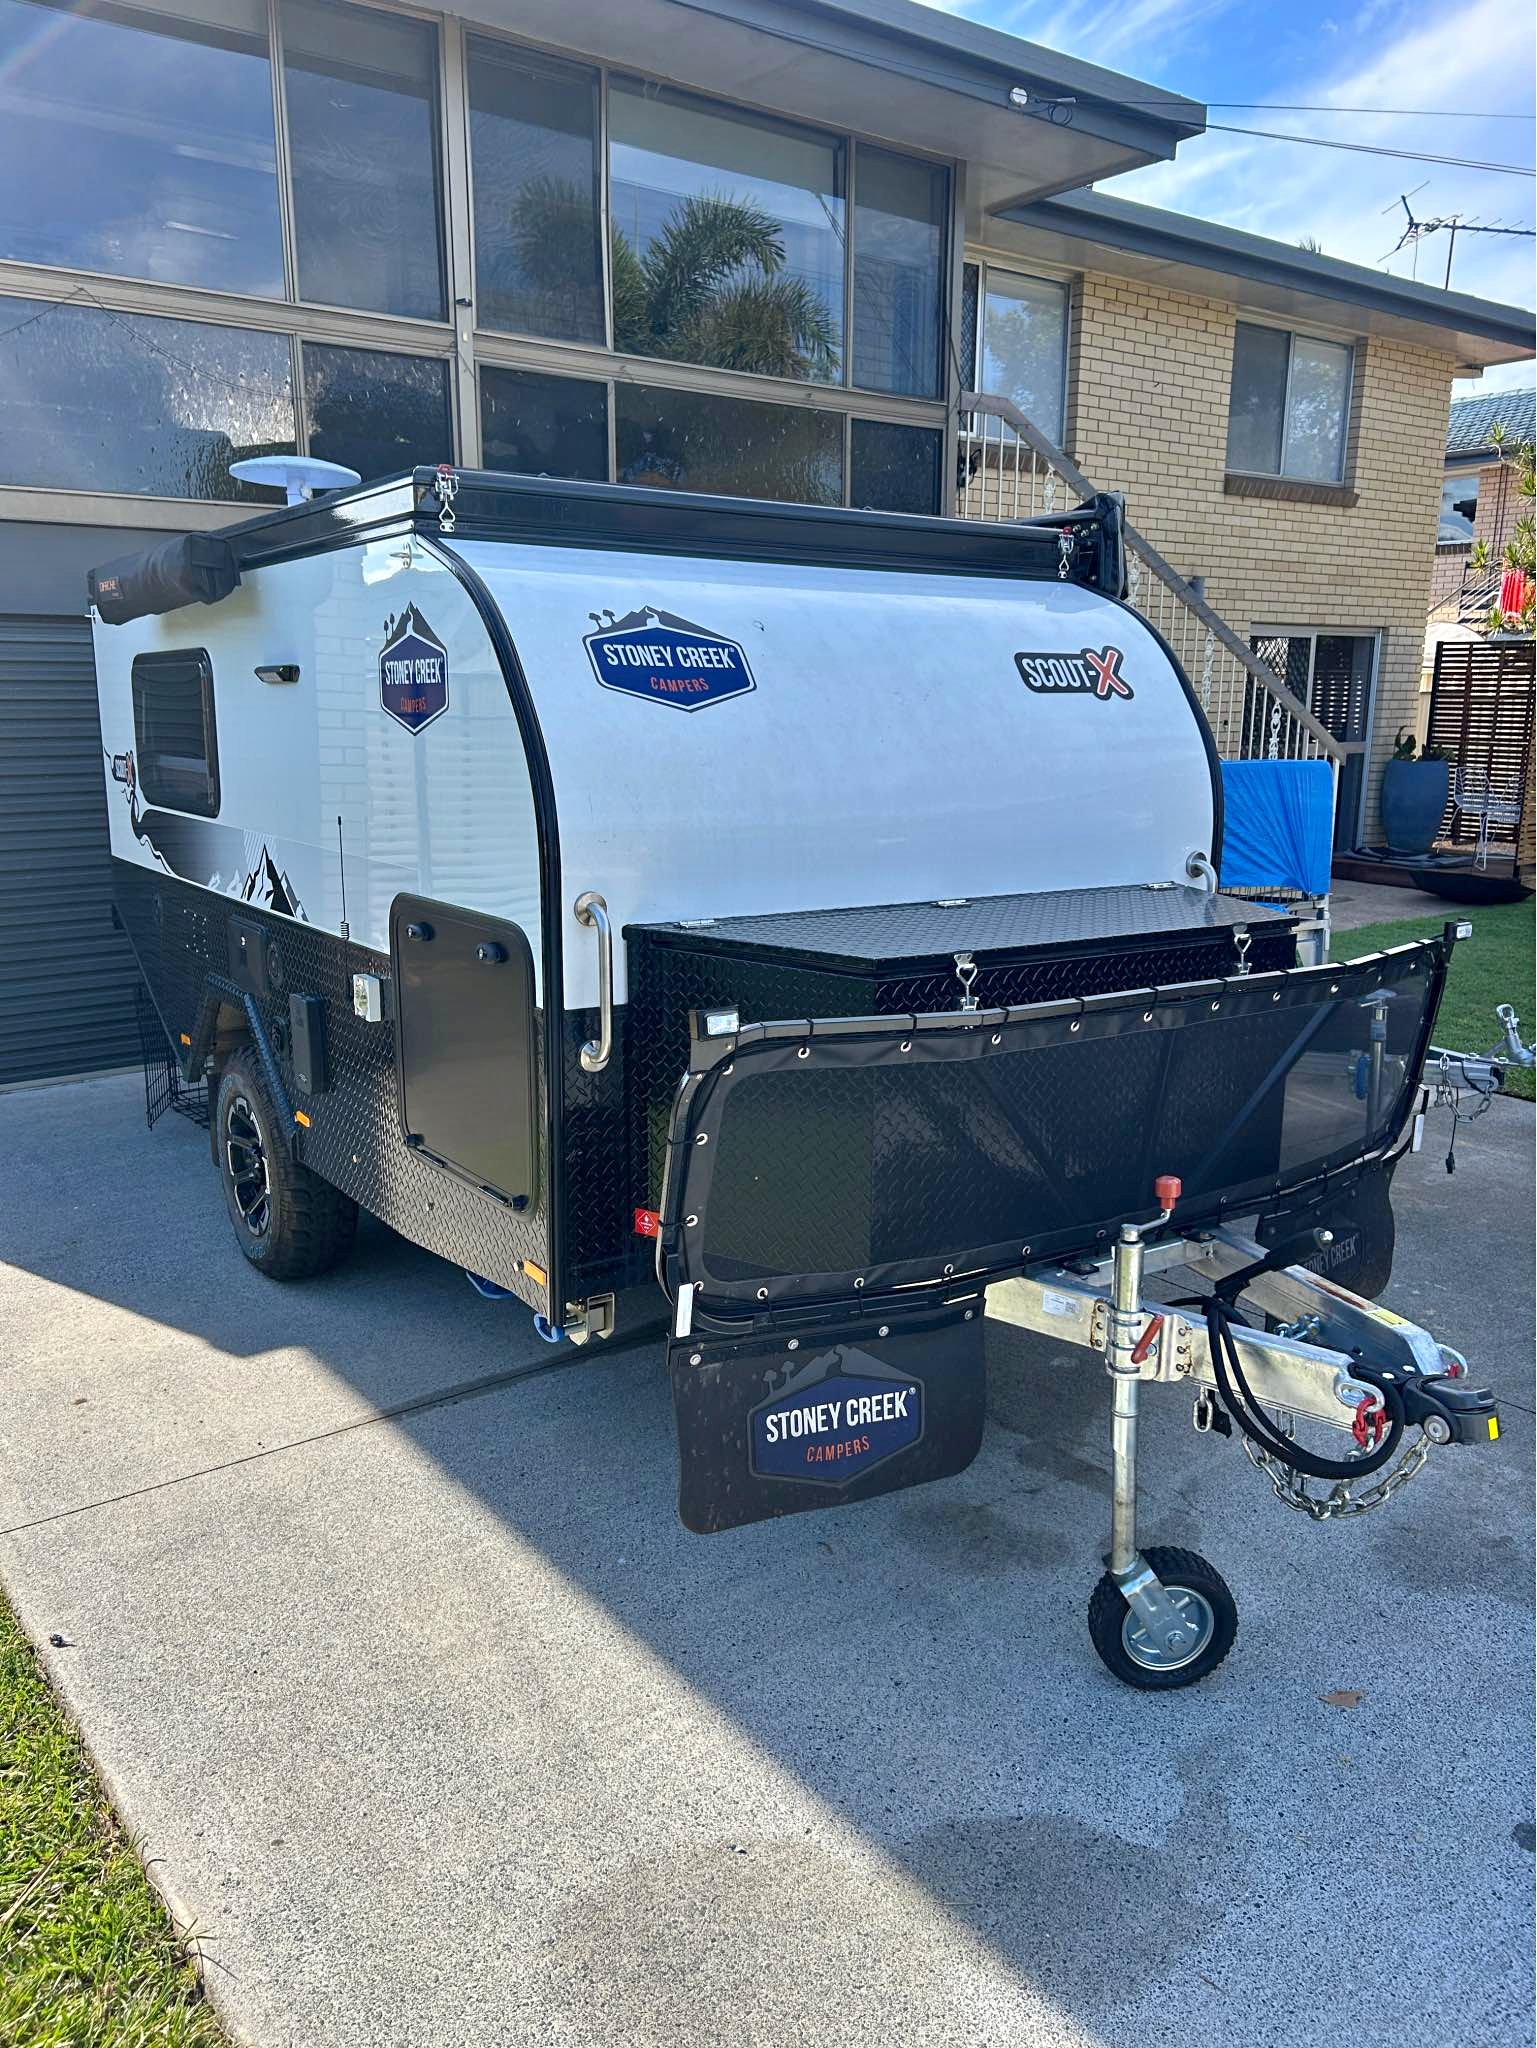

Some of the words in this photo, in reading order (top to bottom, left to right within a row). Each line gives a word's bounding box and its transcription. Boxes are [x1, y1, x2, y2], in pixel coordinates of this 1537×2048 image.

[603, 643, 675, 667] STONEY
[385, 659, 414, 686] STONEY
[650, 676, 710, 693] CAMPERS
[1021, 649, 1129, 695] SCOUT-X
[400, 697, 427, 713] CAMPERS
[766, 1402, 842, 1443] STONEY
[806, 1435, 871, 1463] CAMPERS
